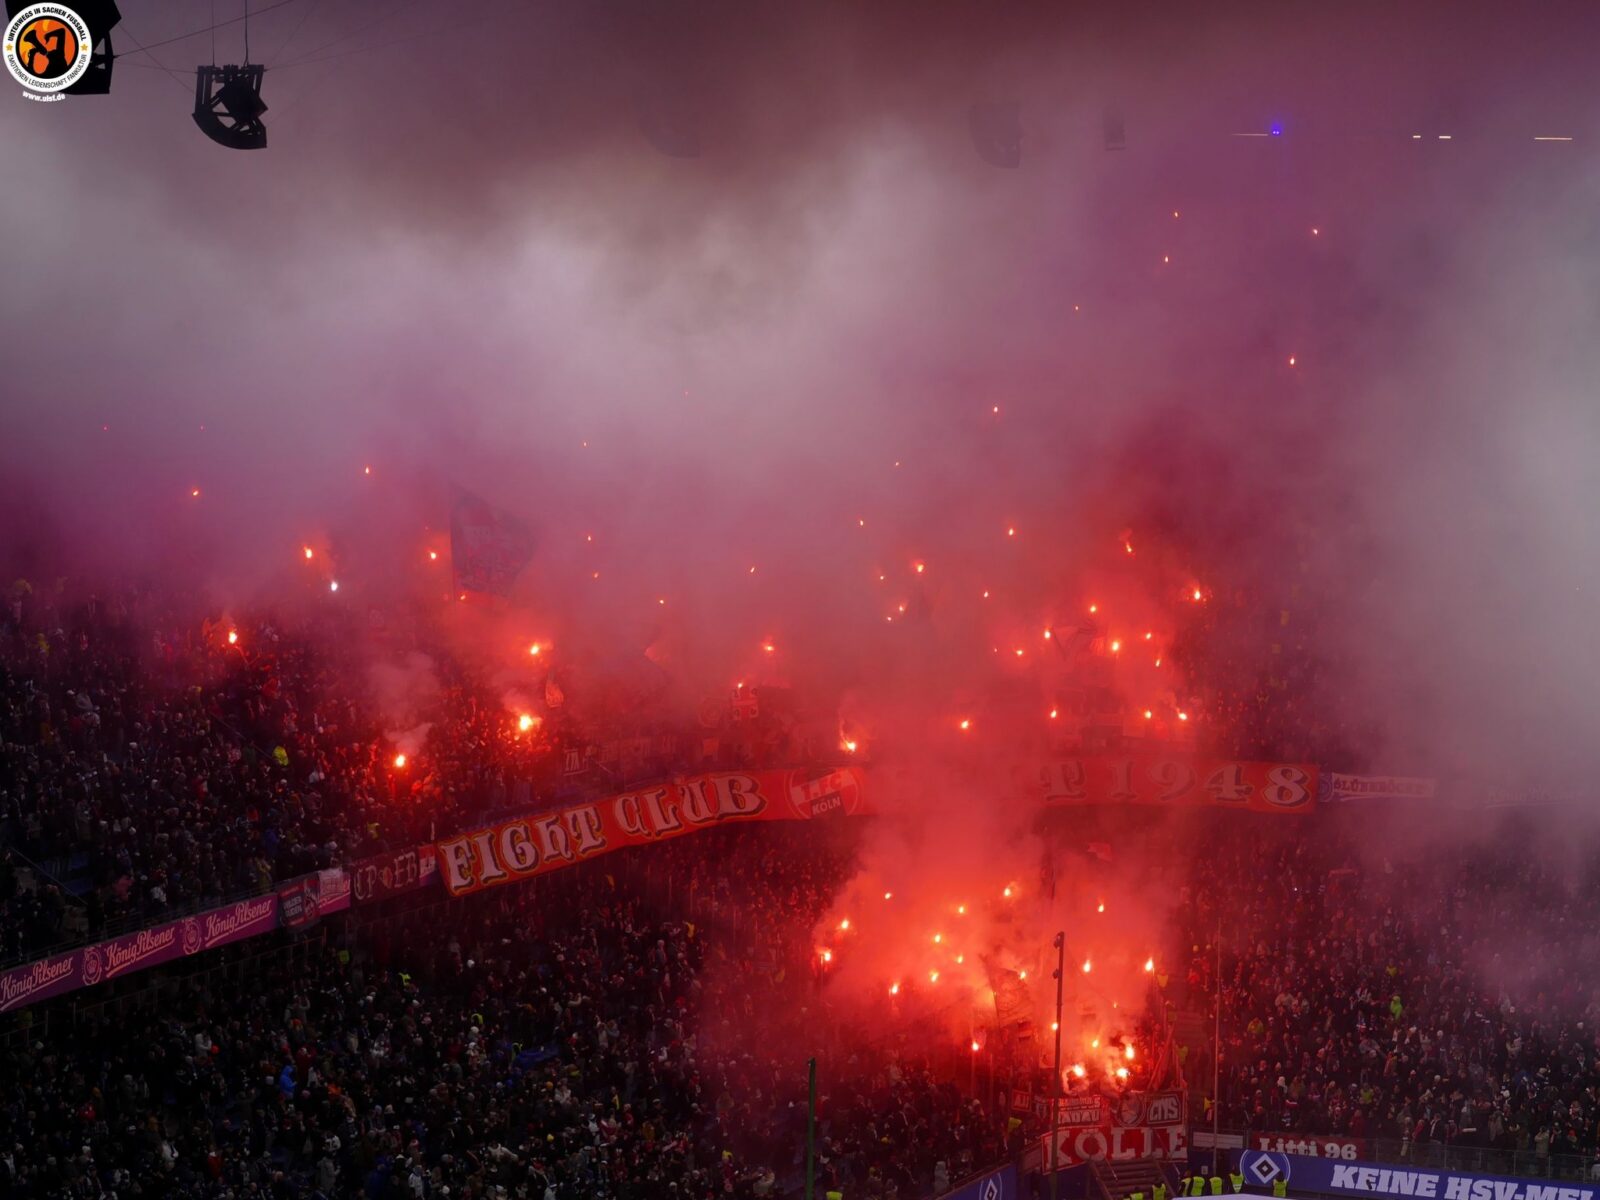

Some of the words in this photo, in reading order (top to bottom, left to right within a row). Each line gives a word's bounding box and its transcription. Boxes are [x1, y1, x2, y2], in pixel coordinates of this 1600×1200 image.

[1107, 759, 1312, 808] 1948
[440, 806, 607, 892] FIGHT
[613, 773, 769, 839] CLUB
[205, 912, 236, 940] König
[234, 898, 274, 928] Pilsener
[105, 944, 137, 971] König
[136, 926, 176, 956] Pilsener
[0, 975, 33, 1003] König
[32, 956, 74, 986] Pilsener
[1045, 1127, 1187, 1169] KÖLLE
[1258, 1137, 1318, 1158] Litti
[1324, 1142, 1357, 1160] 96
[1330, 1164, 1440, 1198] KEINE
